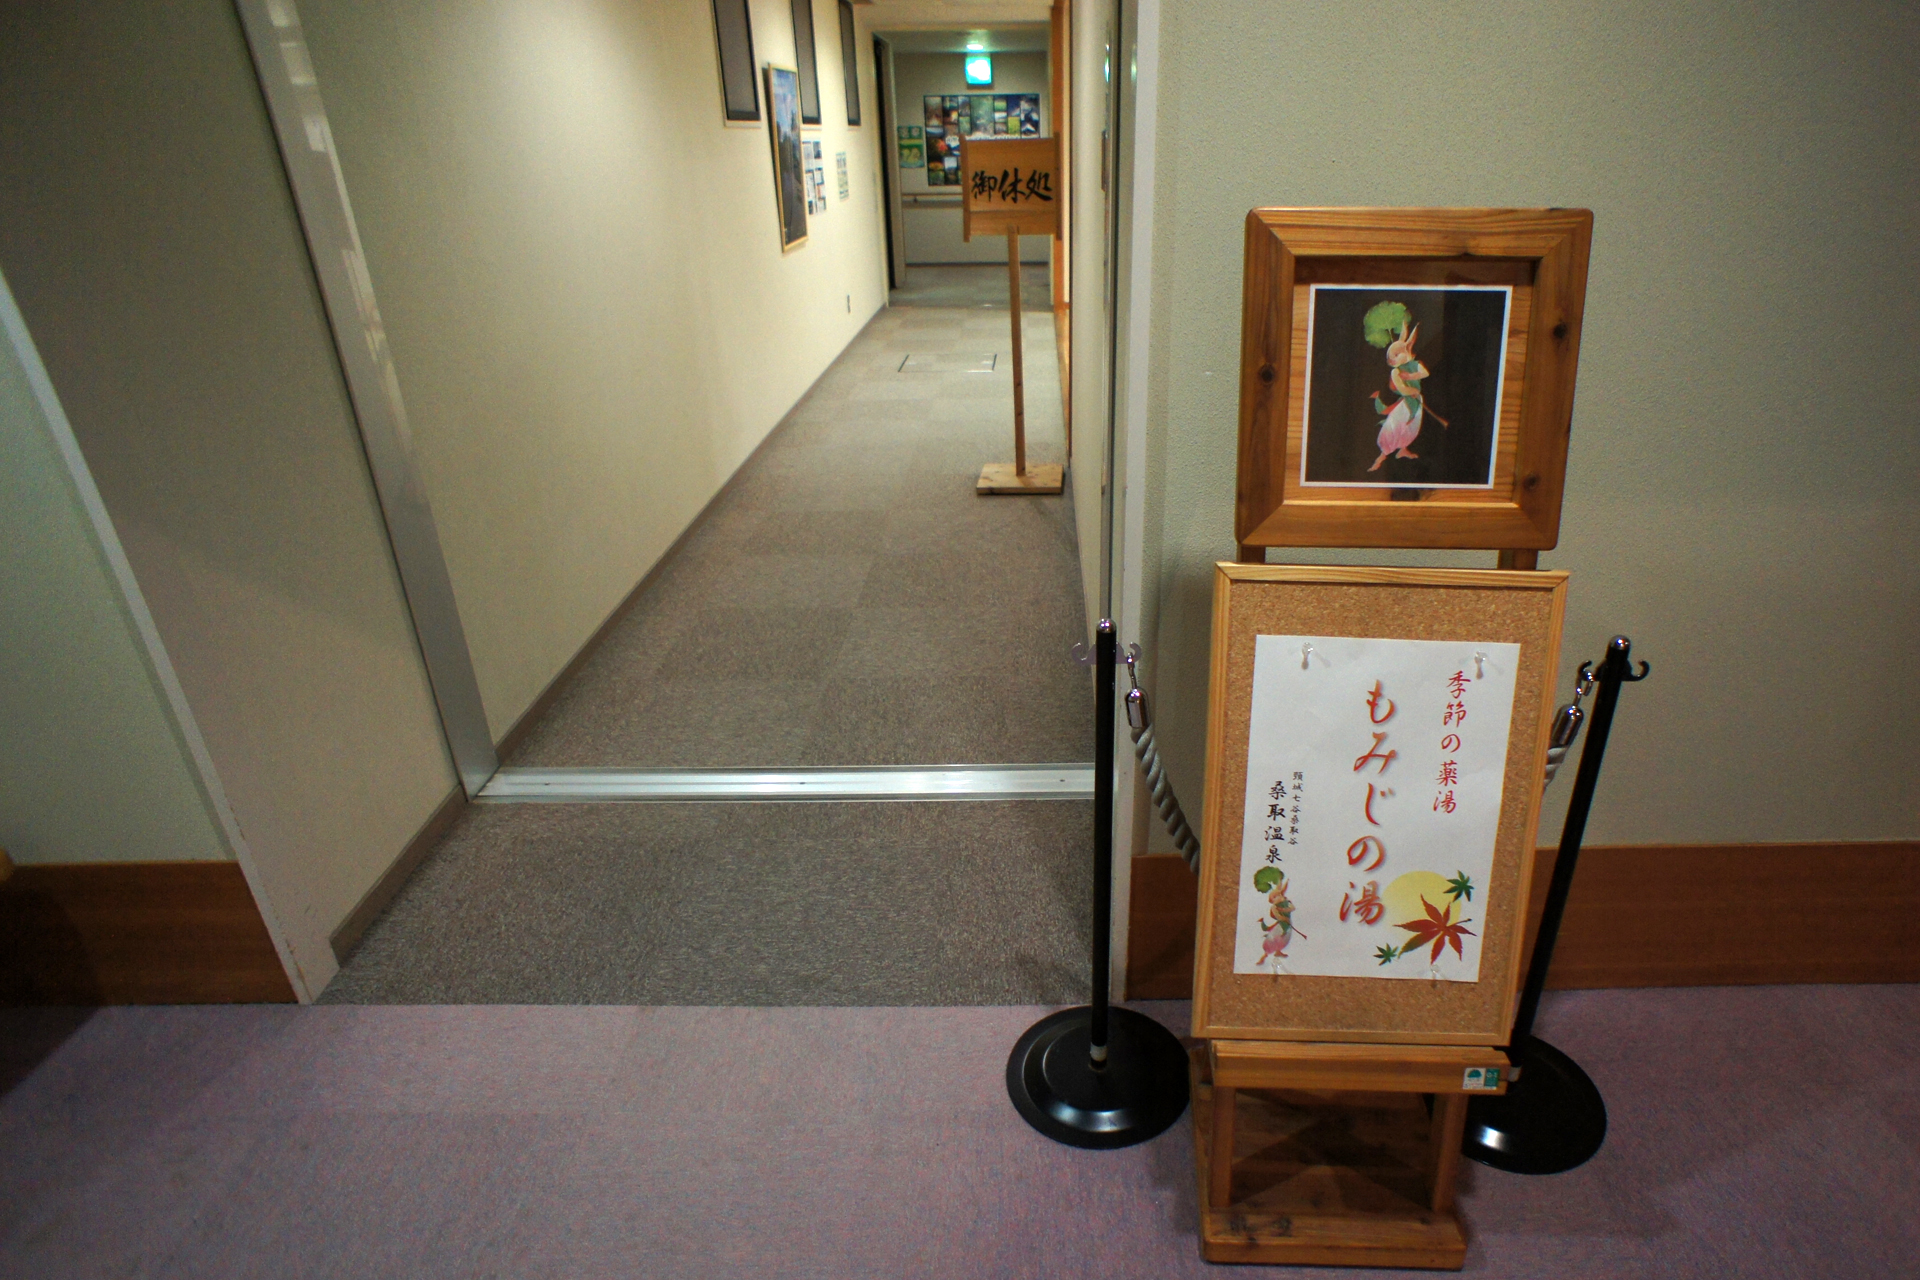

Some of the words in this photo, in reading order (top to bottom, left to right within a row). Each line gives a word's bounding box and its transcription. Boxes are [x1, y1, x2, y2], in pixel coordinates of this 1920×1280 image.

[971, 167, 1053, 204] 御休処
[1433, 670, 1472, 814] 季節の薬湯
[1264, 780, 1287, 864] 桑取温泉
[1339, 679, 1398, 925] もみじの湯
